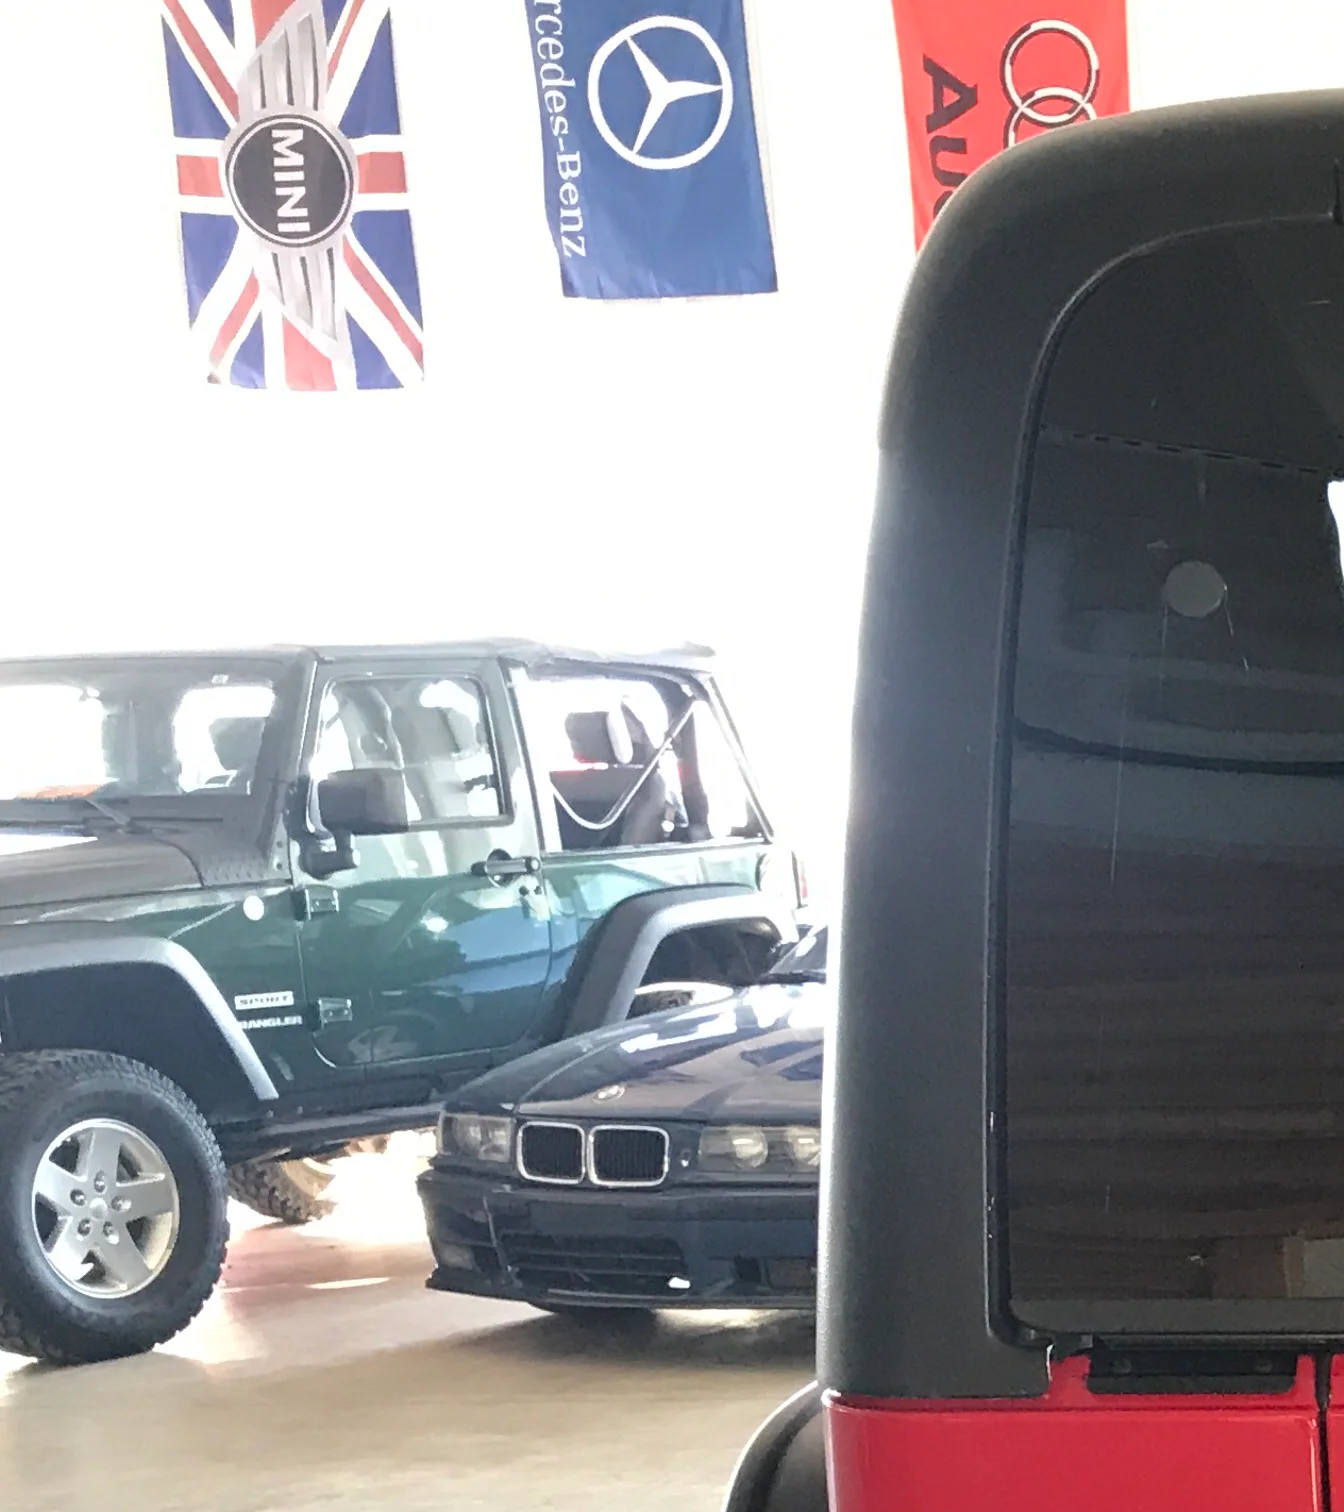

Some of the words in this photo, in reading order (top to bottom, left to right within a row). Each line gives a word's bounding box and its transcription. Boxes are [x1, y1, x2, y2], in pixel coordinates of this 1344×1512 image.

[271, 129, 311, 232] MINI
[534, 0, 587, 258] rcedes-Benz
[922, 53, 978, 220] Au
[237, 1015, 303, 1030] RANGLER
